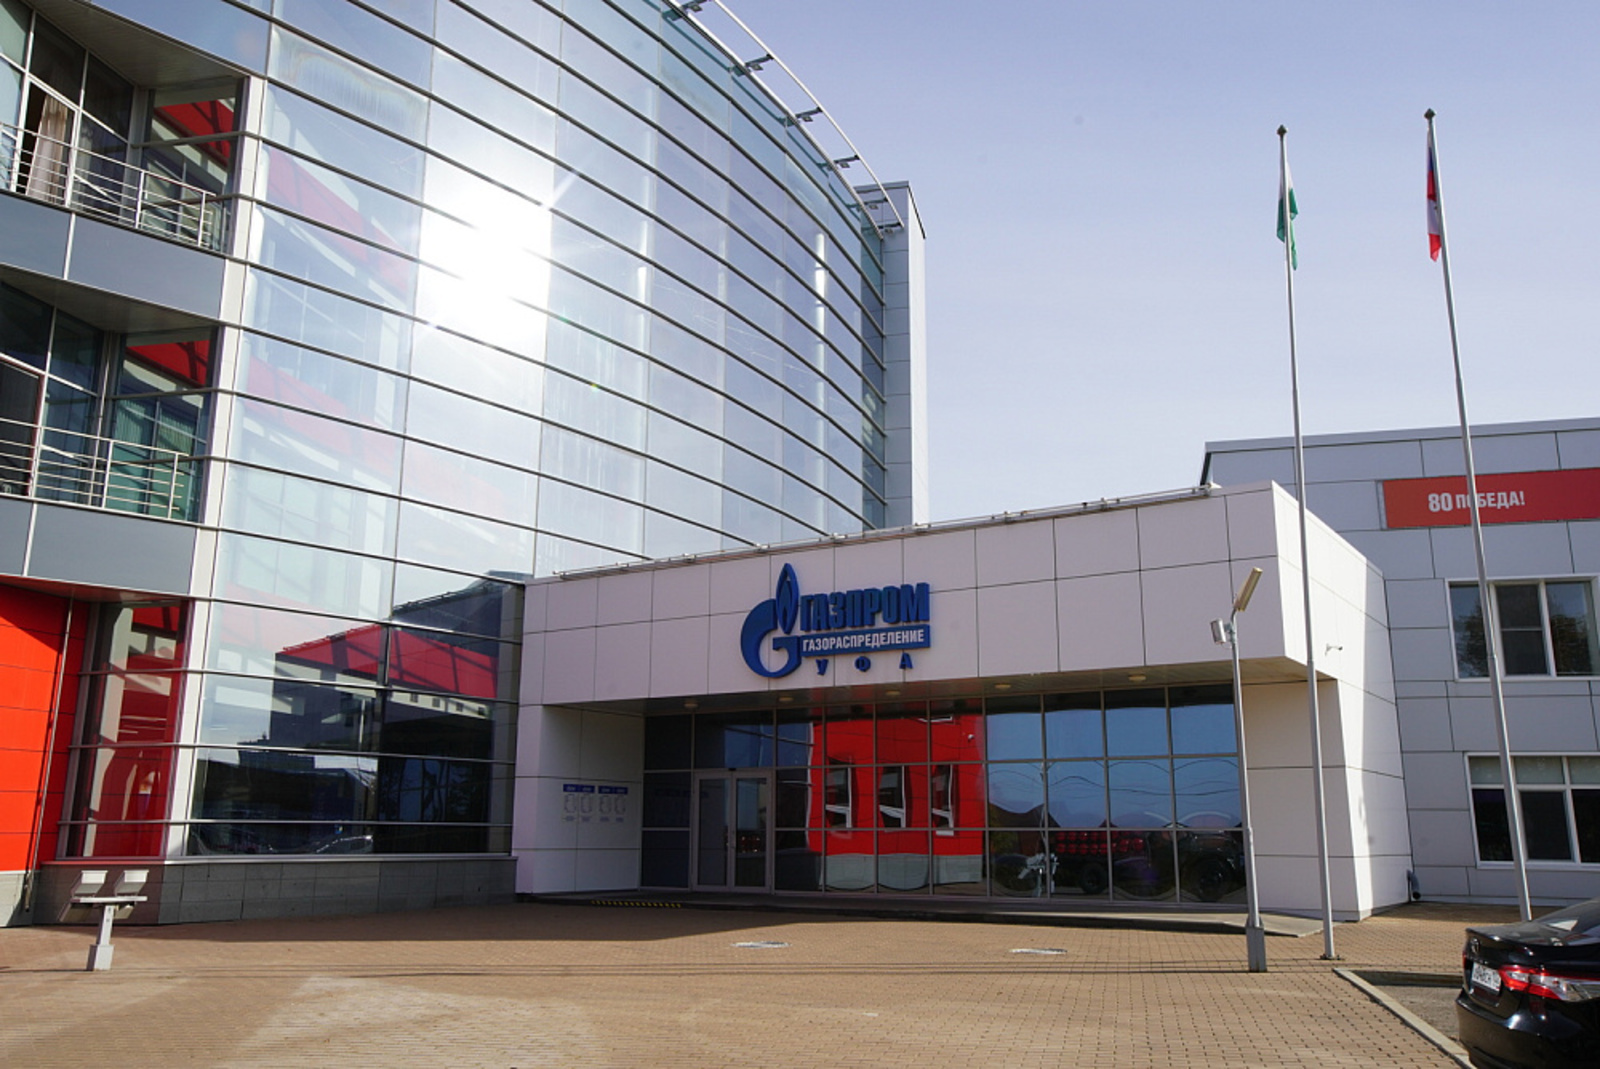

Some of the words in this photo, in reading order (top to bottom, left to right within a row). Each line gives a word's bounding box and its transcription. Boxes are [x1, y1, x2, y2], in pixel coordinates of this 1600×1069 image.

[1428, 493, 1453, 512] 80
[801, 583, 930, 631] ГАЗПРОМ
[803, 629, 924, 652] ГАЗОРАСПРЕДЕЛЕНИЕ
